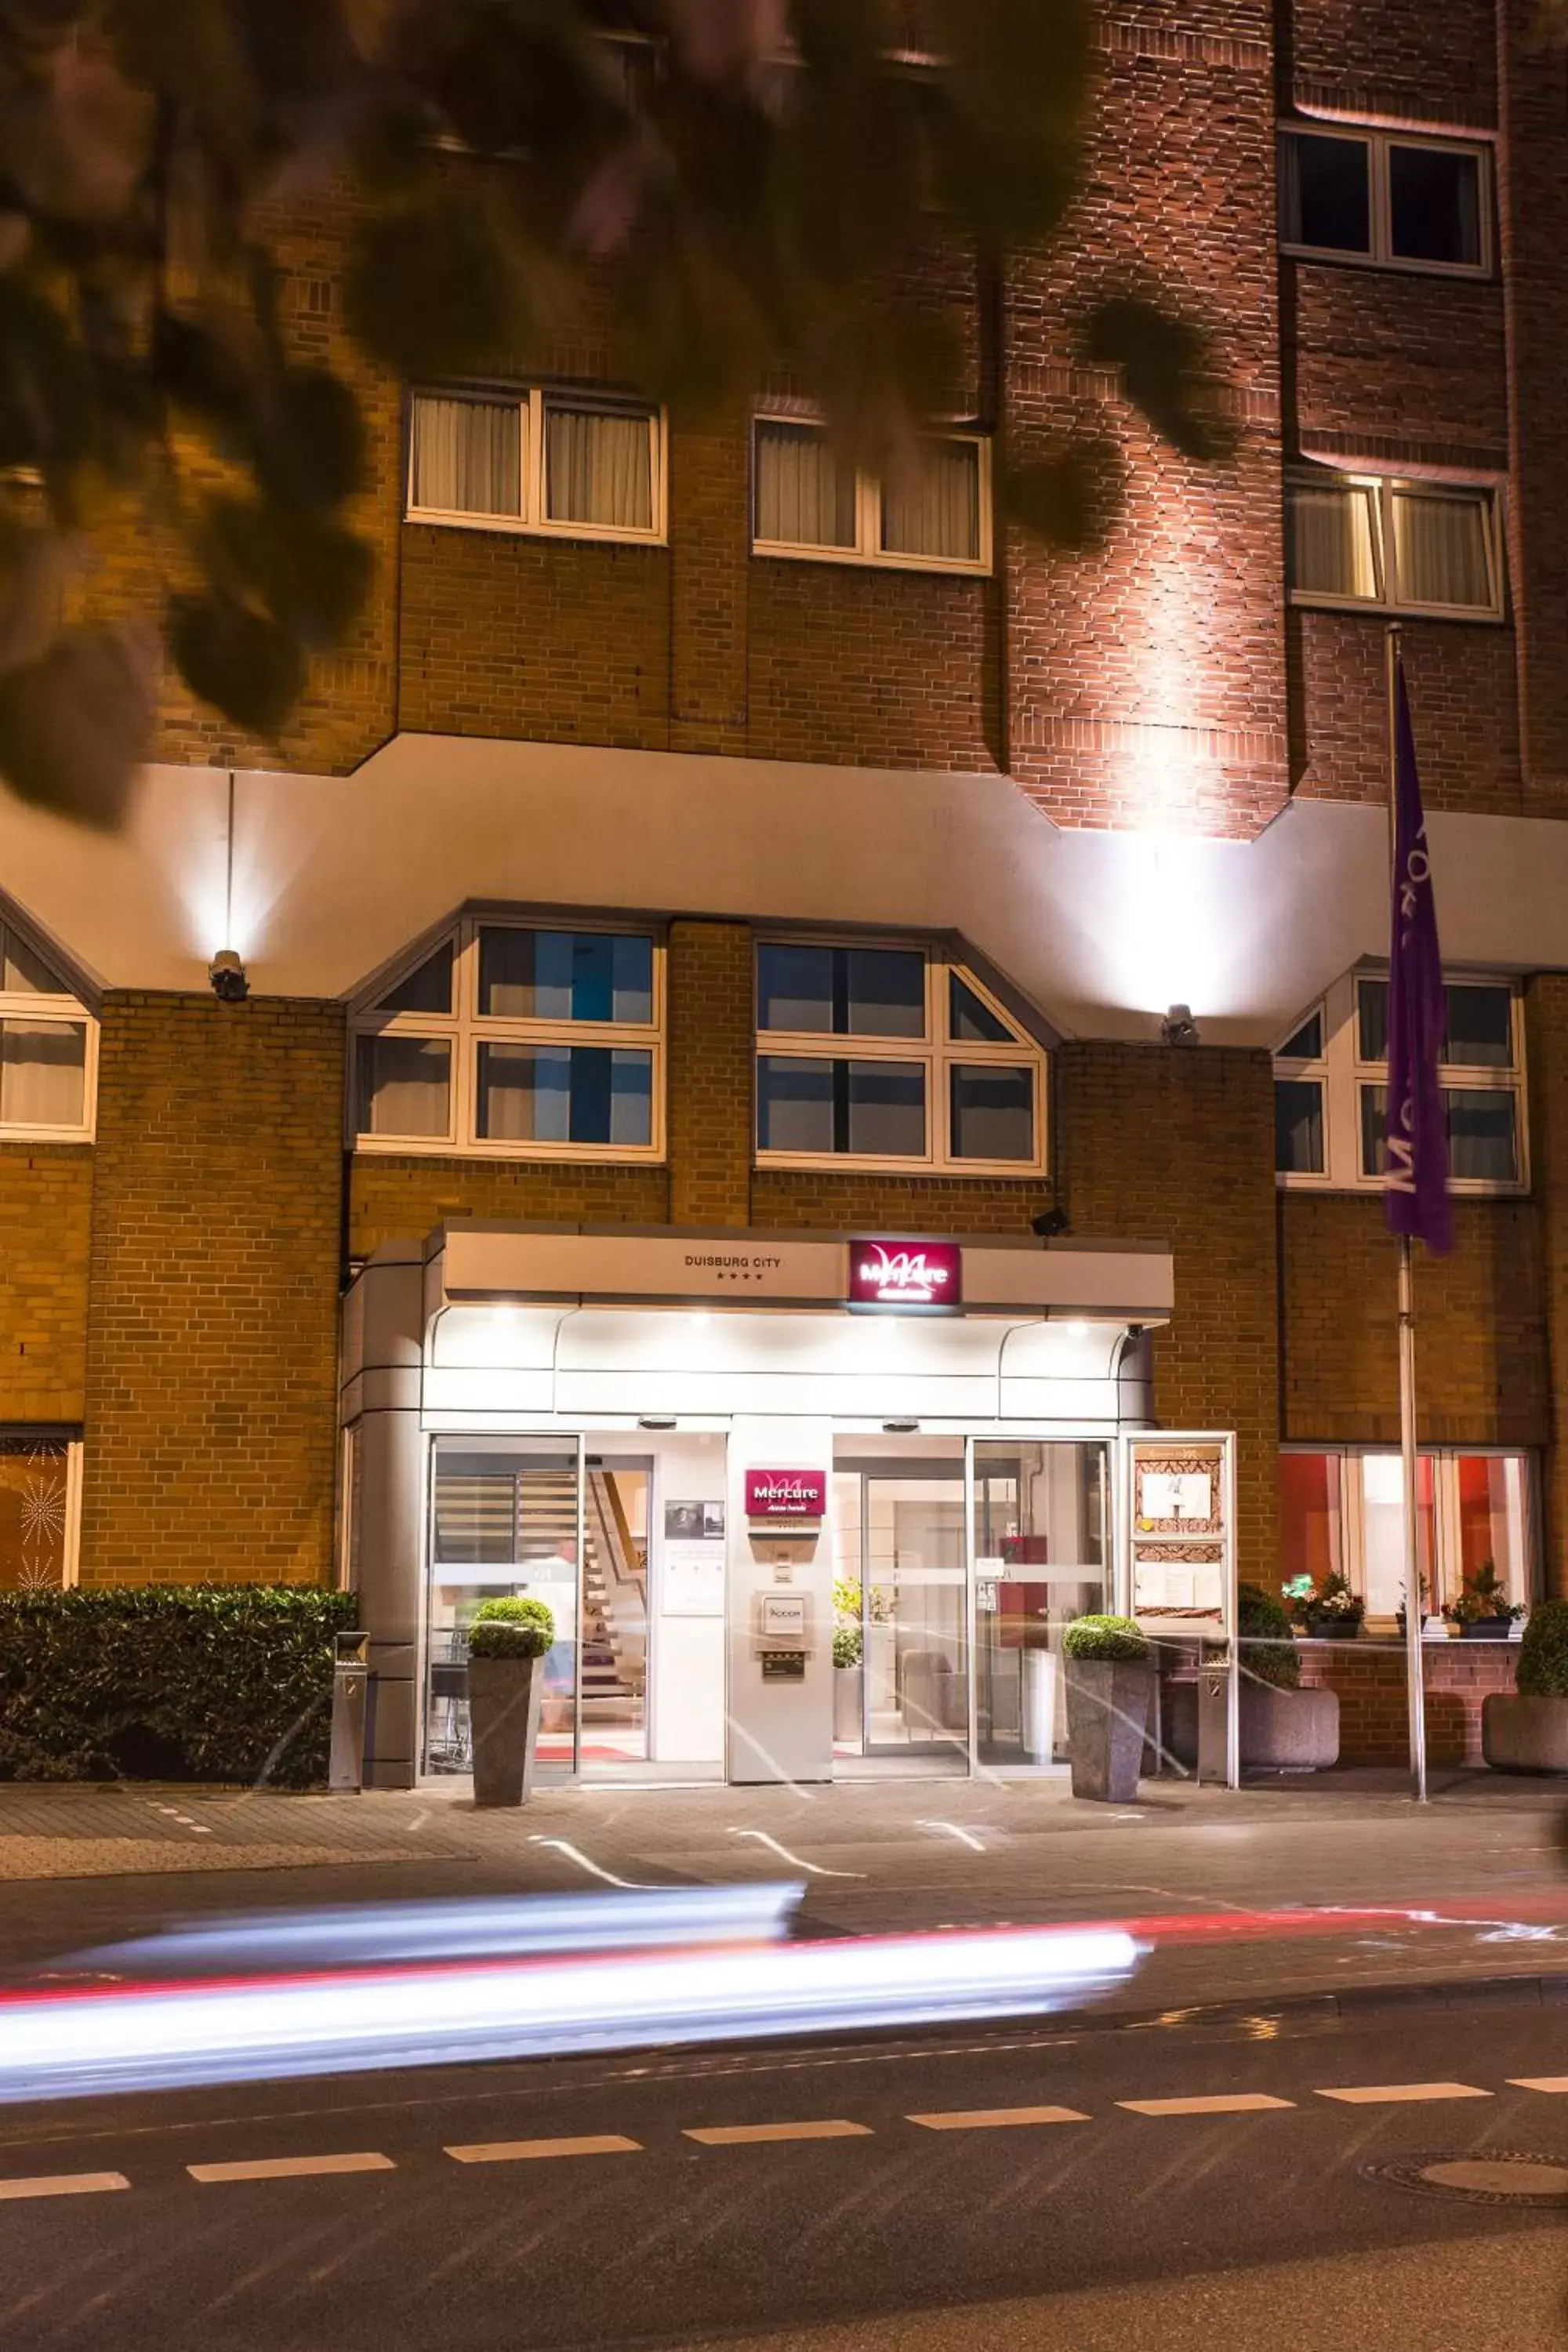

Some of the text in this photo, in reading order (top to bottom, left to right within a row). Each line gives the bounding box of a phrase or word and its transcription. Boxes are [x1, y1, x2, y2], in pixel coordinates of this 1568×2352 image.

[684, 1255, 781, 1268] DUISBURG CITY
[753, 1486, 818, 1498] Mercure
